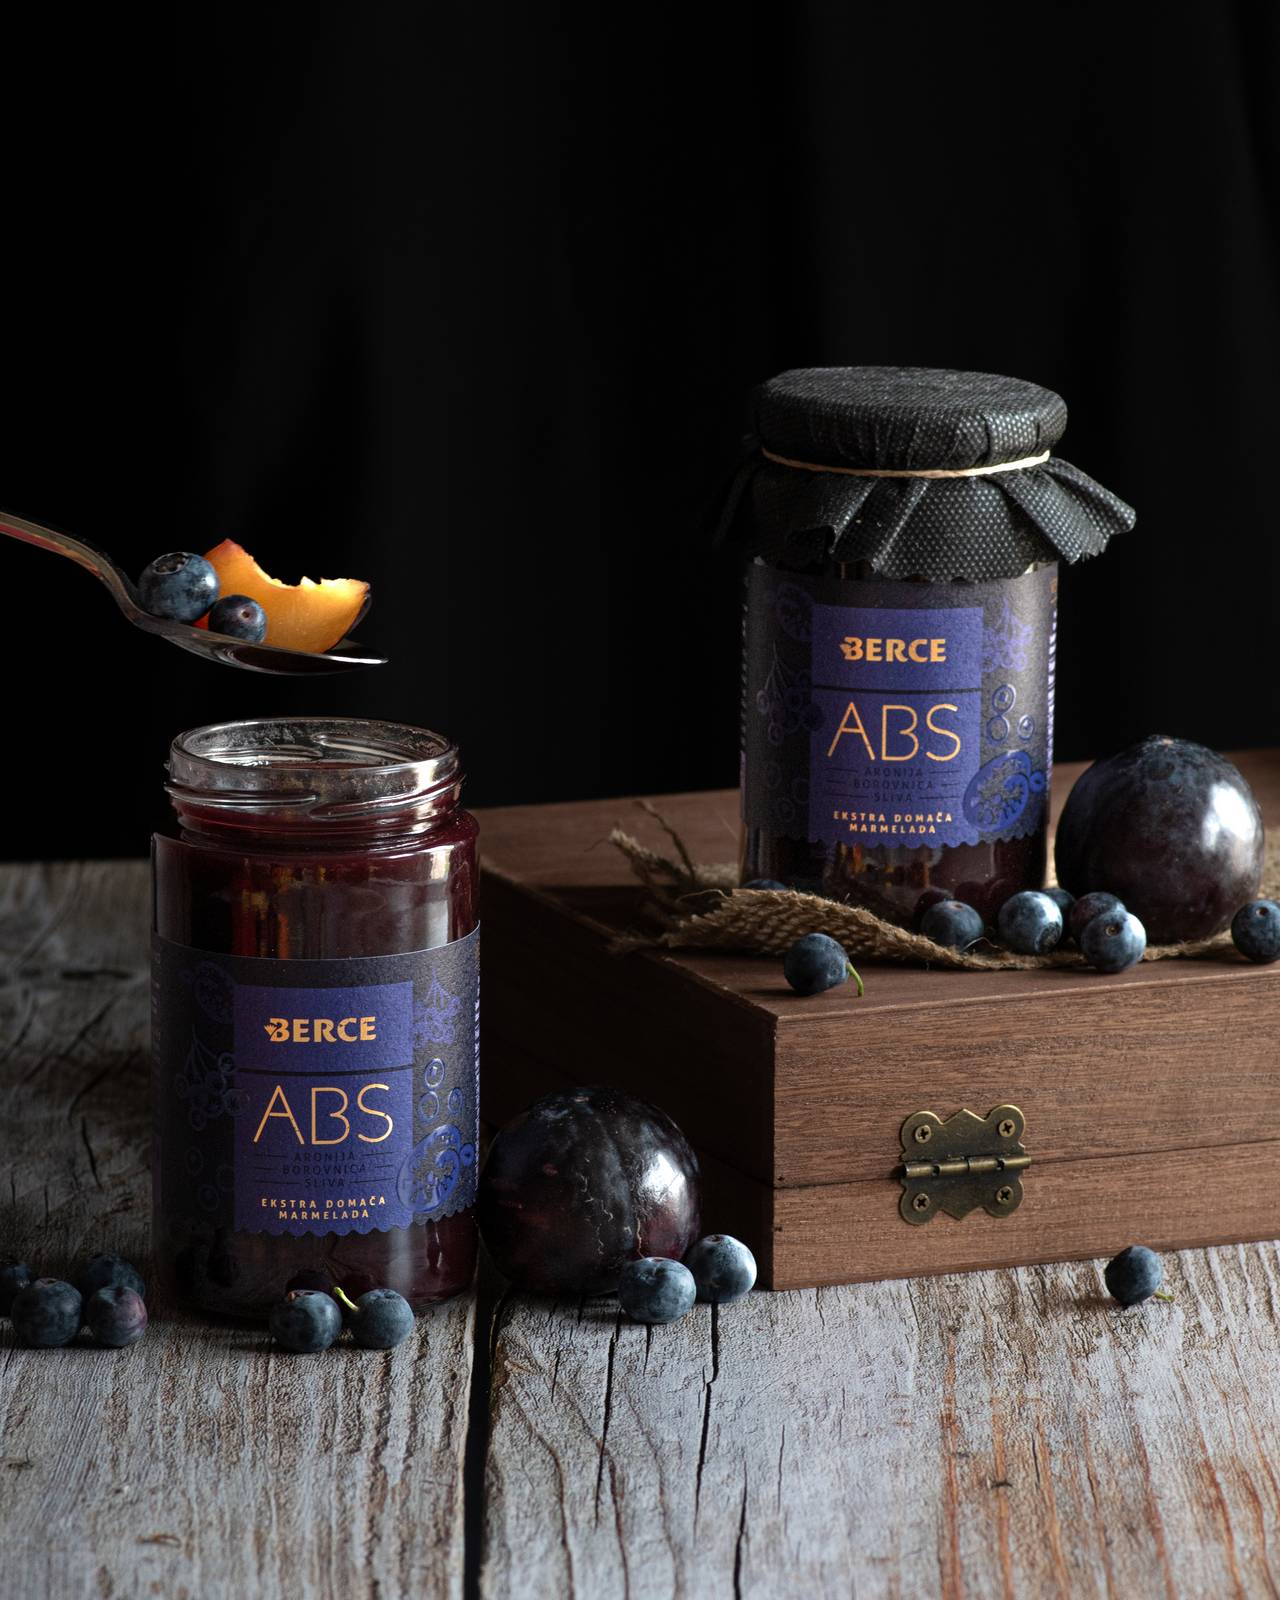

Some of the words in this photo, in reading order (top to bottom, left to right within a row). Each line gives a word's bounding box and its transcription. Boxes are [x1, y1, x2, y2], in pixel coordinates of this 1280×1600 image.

[840, 636, 946, 663] BERCE
[826, 701, 961, 762] ABS
[863, 766, 925, 778] ARONIJA
[873, 792, 913, 803] SLIVA
[833, 811, 885, 823] EKSTRA
[893, 810, 953, 823] DOMAČA
[849, 822, 937, 834] MARMELADA
[264, 1015, 377, 1043] BERCE
[252, 1082, 395, 1146] ABS
[291, 1150, 356, 1162] ARONIJA
[304, 1177, 346, 1188] SLIVA
[261, 1197, 317, 1209] EKSTRA
[326, 1195, 387, 1208] DOMAČA
[278, 1209, 369, 1220] MARMELADA
